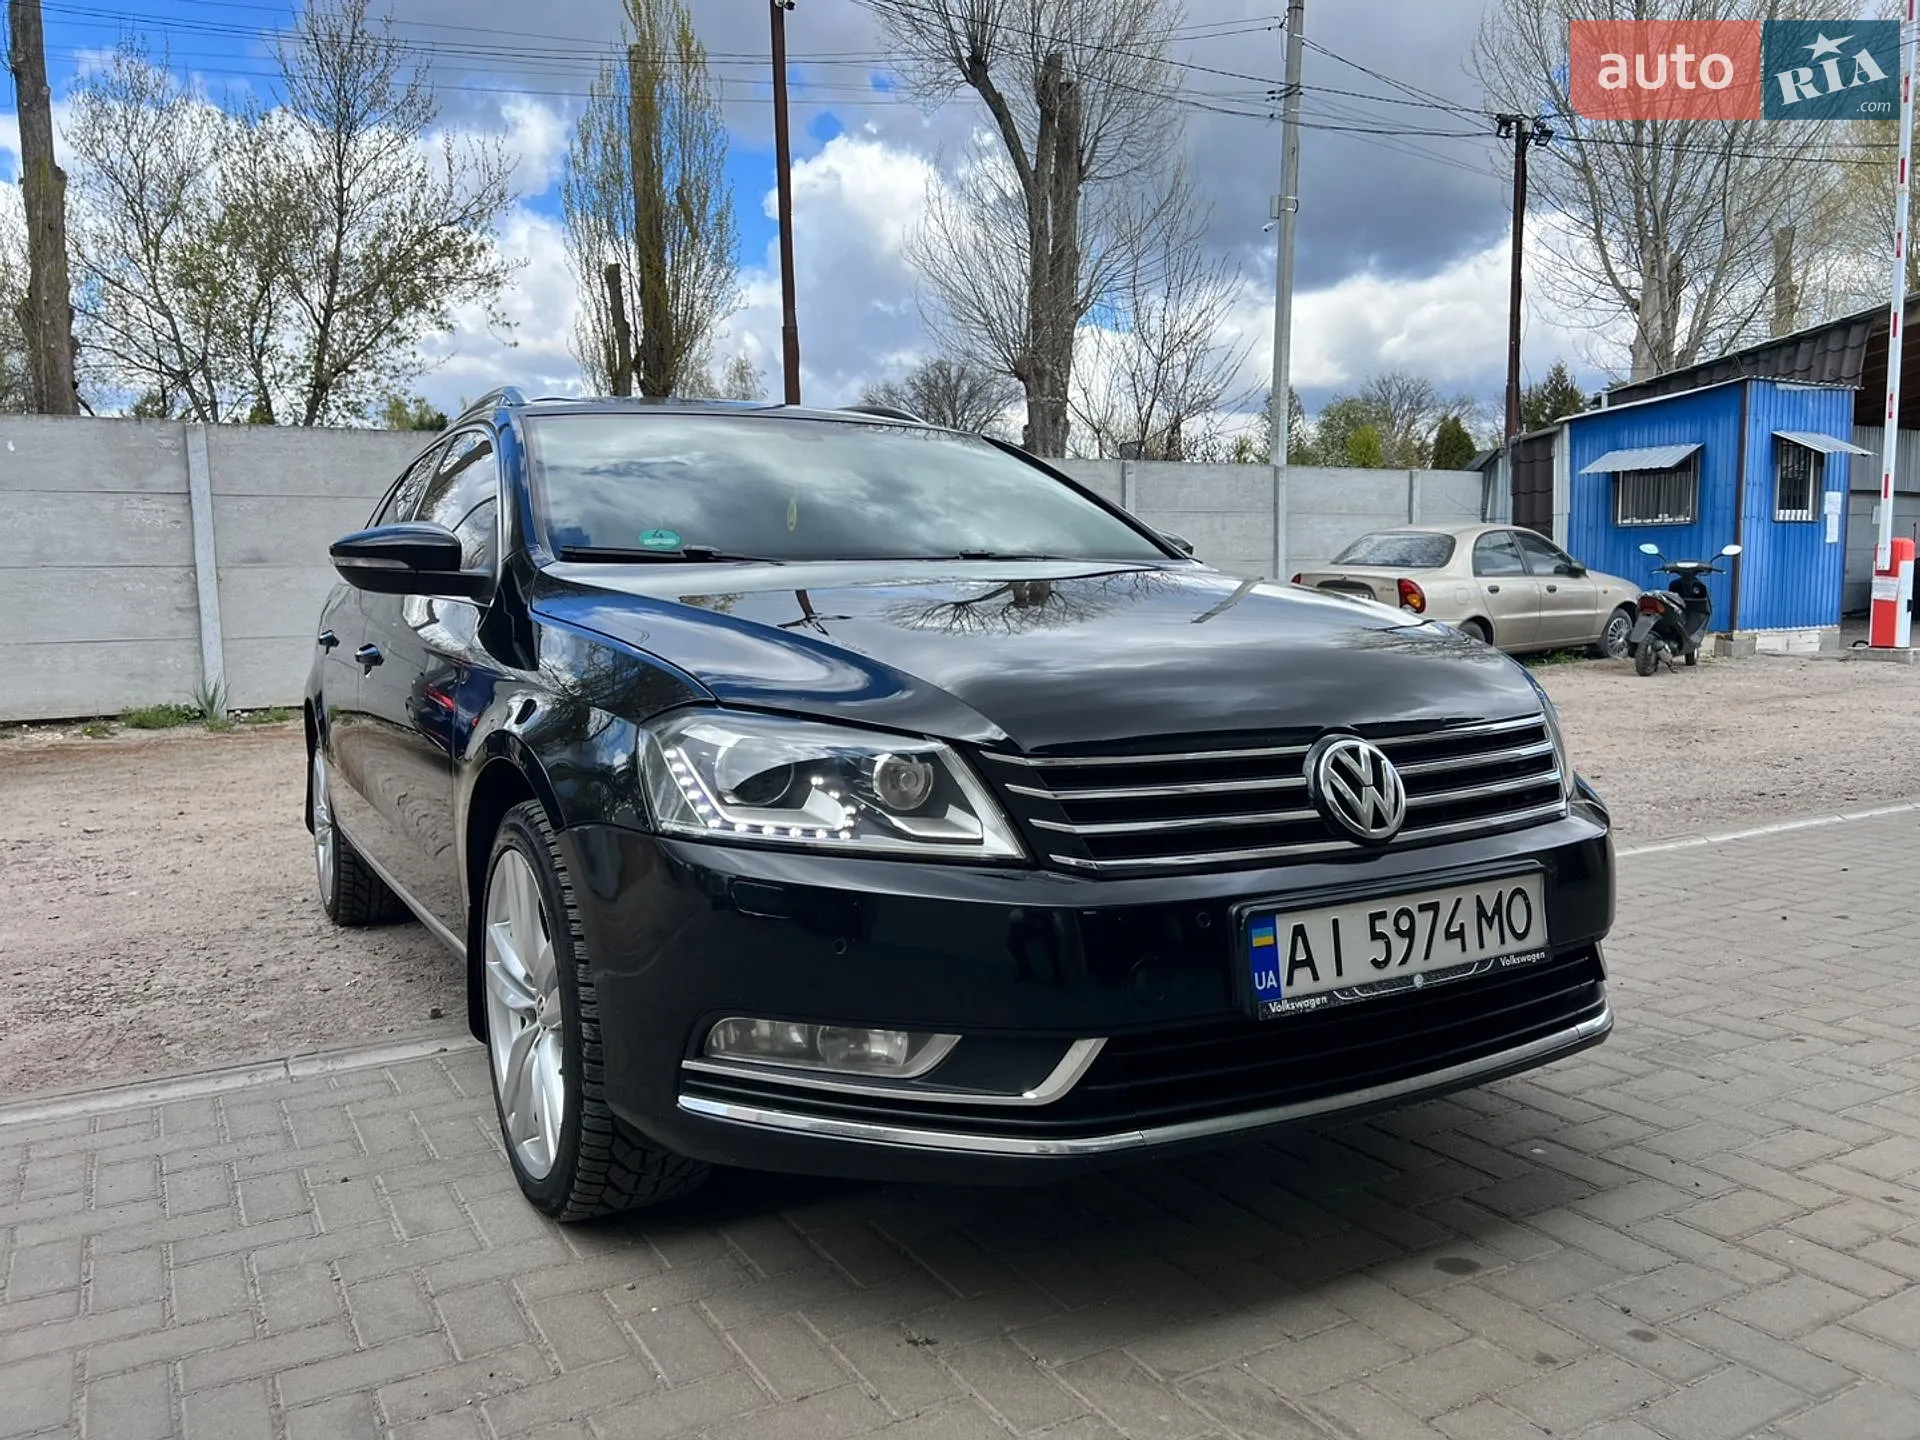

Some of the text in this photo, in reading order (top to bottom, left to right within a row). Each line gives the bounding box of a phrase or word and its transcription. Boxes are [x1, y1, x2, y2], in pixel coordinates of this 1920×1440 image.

[1499, 951, 1546, 967] Volkswagen
[1254, 970, 1278, 991] UA
[1268, 996, 1328, 1013] Volkswagen
